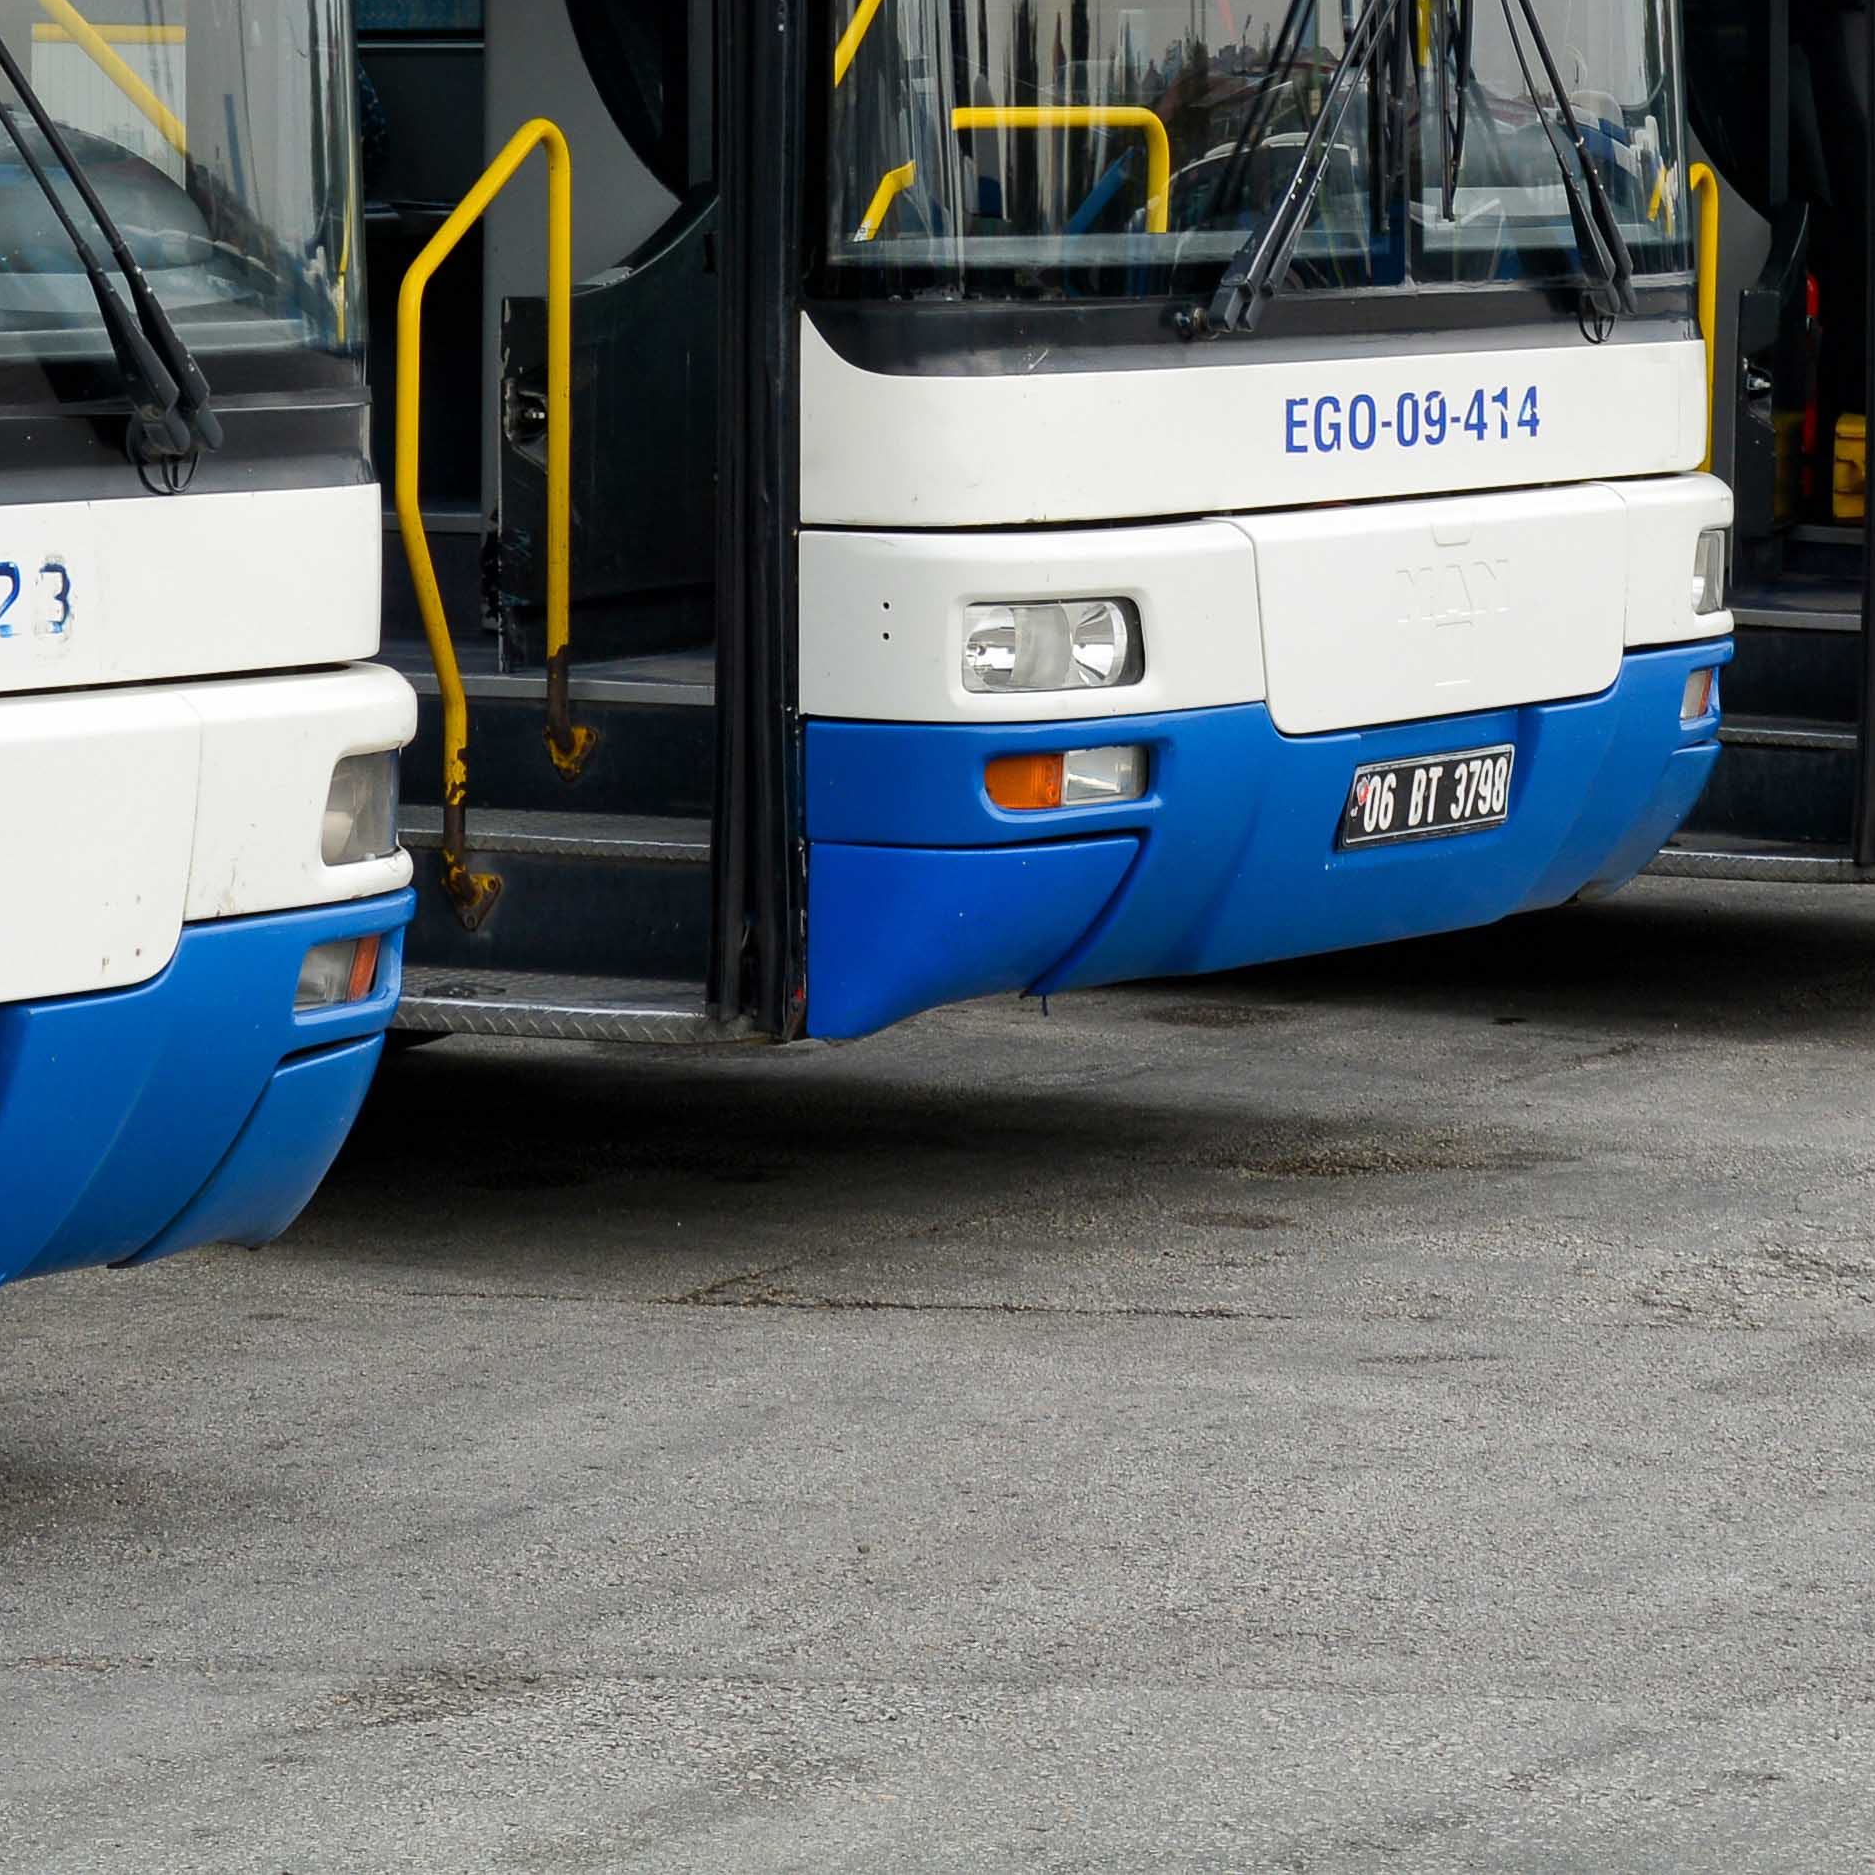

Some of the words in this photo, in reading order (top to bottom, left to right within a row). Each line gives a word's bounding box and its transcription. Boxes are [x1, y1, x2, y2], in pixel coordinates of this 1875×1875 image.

[1285, 385, 1541, 454] EGO-09-414
[1362, 771, 1397, 831] 06
[1407, 766, 1444, 826] BT
[1450, 753, 1508, 824] 3798
